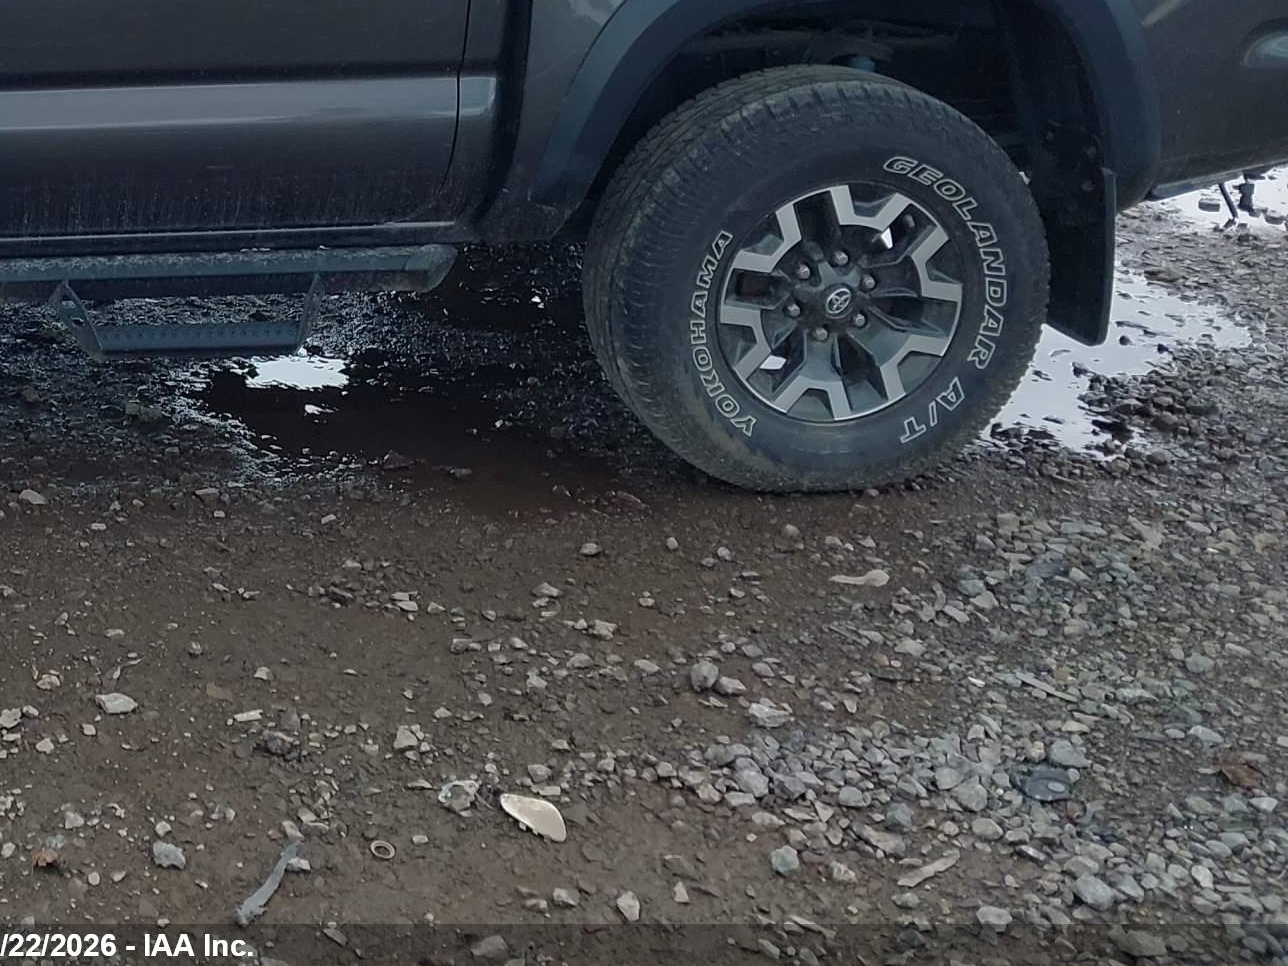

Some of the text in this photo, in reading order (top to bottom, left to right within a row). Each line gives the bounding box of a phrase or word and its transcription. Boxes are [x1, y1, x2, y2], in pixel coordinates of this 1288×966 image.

[690, 231, 758, 436] YOKOHAMA
[883, 156, 1007, 443] GEOLANDAR A/T
